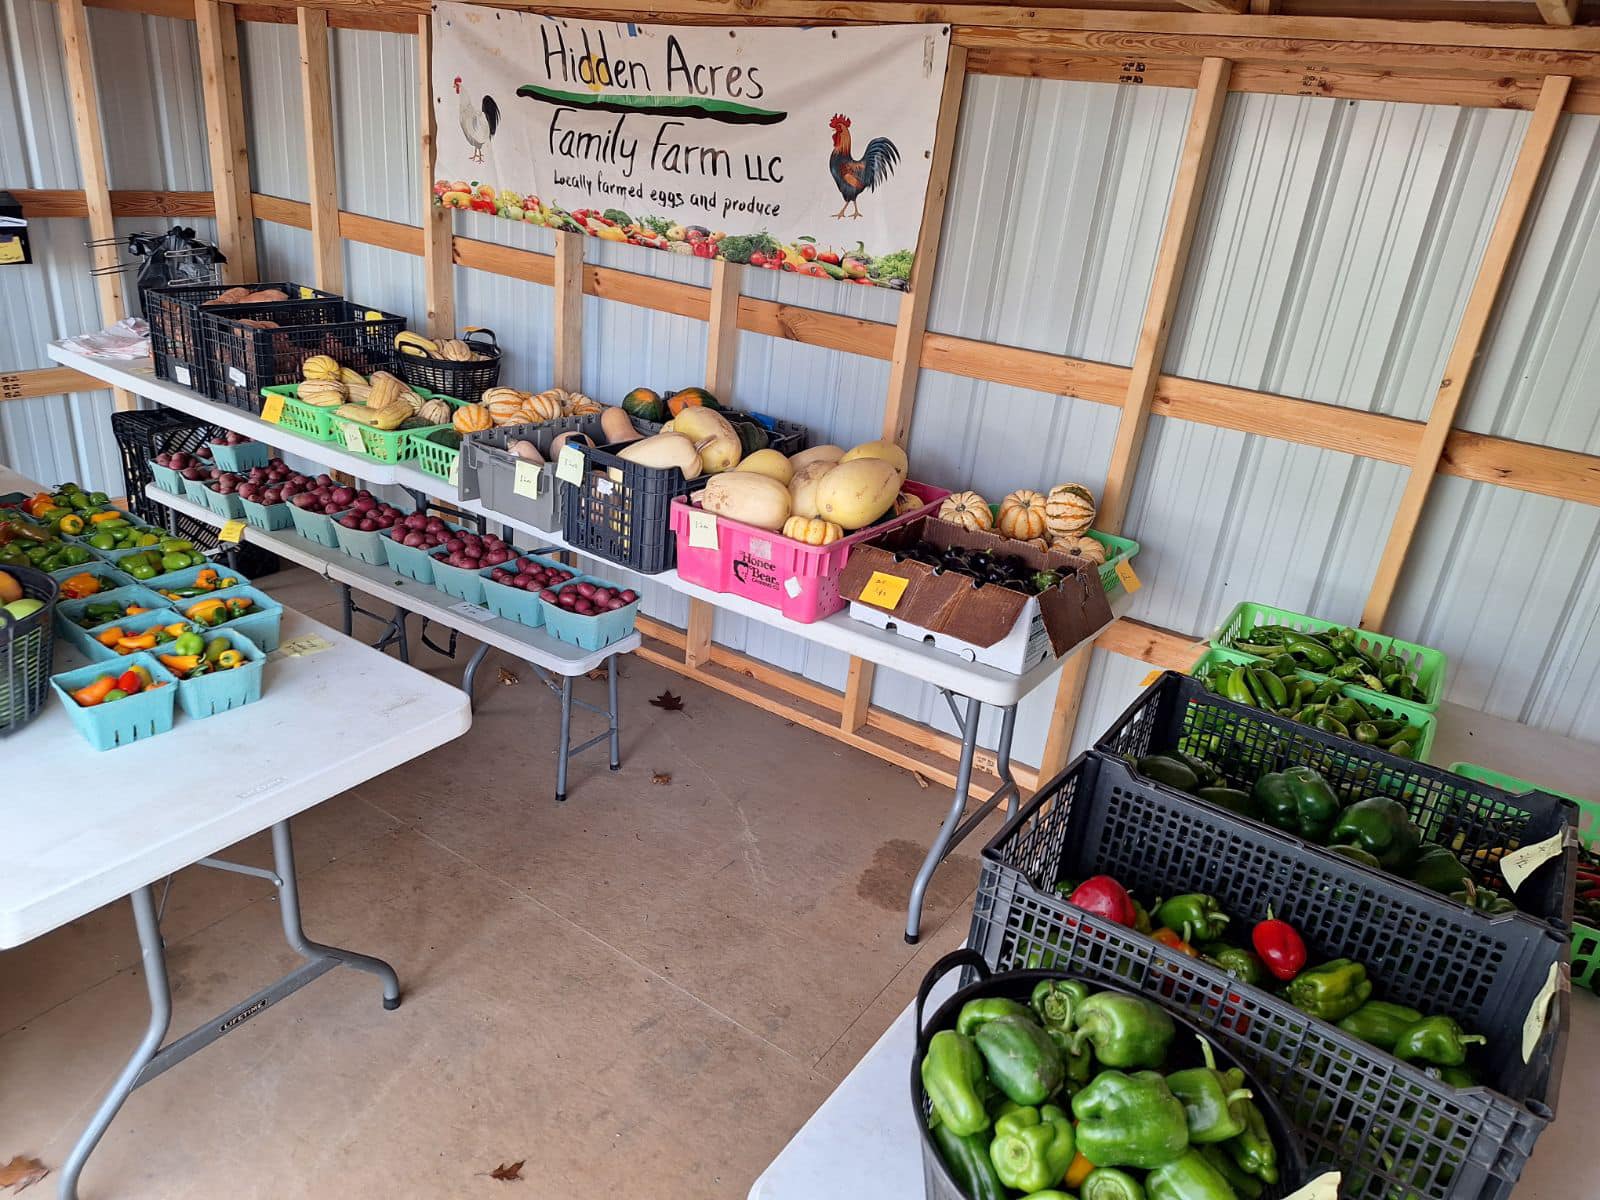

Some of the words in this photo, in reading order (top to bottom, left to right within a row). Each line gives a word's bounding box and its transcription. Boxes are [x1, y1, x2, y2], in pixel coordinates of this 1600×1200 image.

[540, 23, 651, 91] Hidden
[666, 34, 764, 99] Acres
[549, 107, 638, 177] Family
[651, 122, 731, 178] Farm
[745, 154, 784, 183] LLC
[554, 169, 592, 196] Locally
[597, 171, 643, 199] farmed
[650, 188, 684, 208] eggs
[690, 191, 717, 212] and
[723, 197, 781, 218] produce
[742, 551, 776, 571] Honee
[751, 567, 777, 583] Bear
